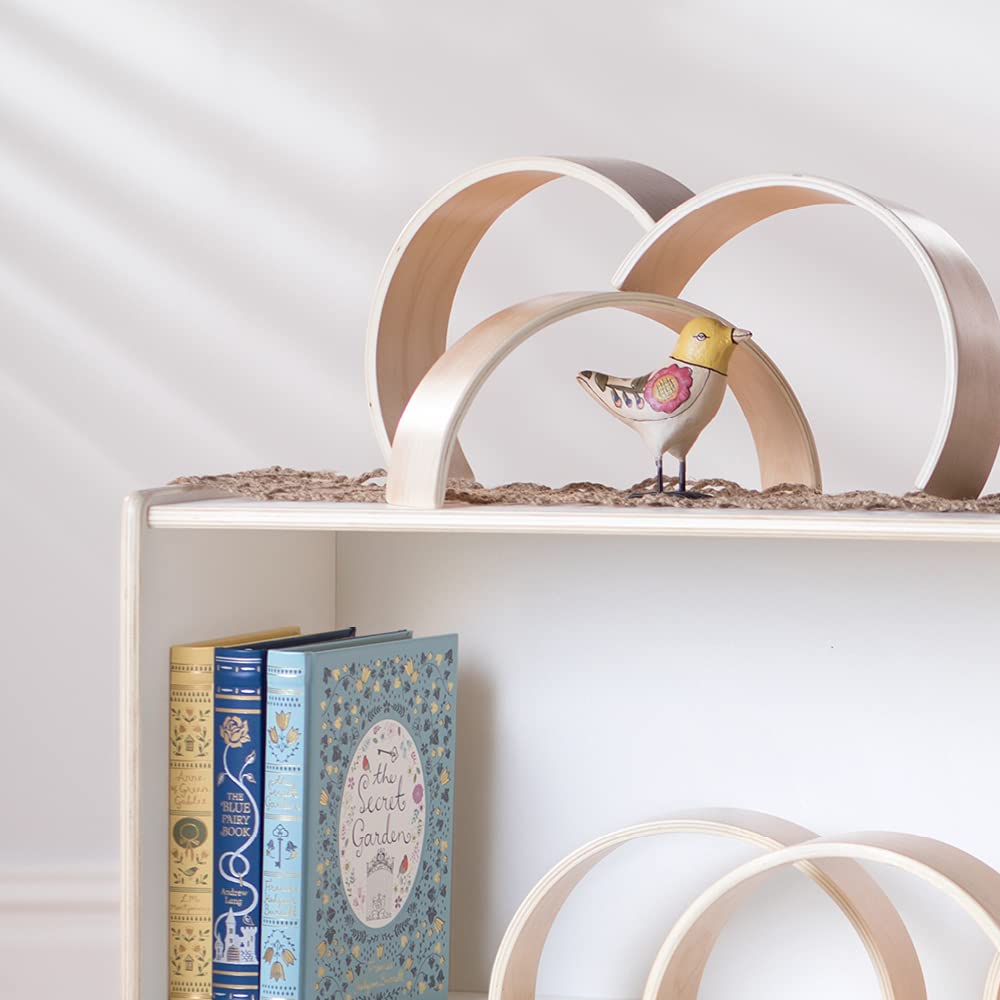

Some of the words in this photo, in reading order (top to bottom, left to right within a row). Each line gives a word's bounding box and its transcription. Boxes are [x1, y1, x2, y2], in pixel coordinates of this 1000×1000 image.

[373, 763, 397, 784] the
[227, 792, 244, 801] THE
[358, 774, 406, 814] Secret
[221, 801, 251, 813] BLUE
[222, 815, 250, 825] FAIRY
[221, 826, 251, 837] BOOK
[352, 813, 411, 857] Garden
